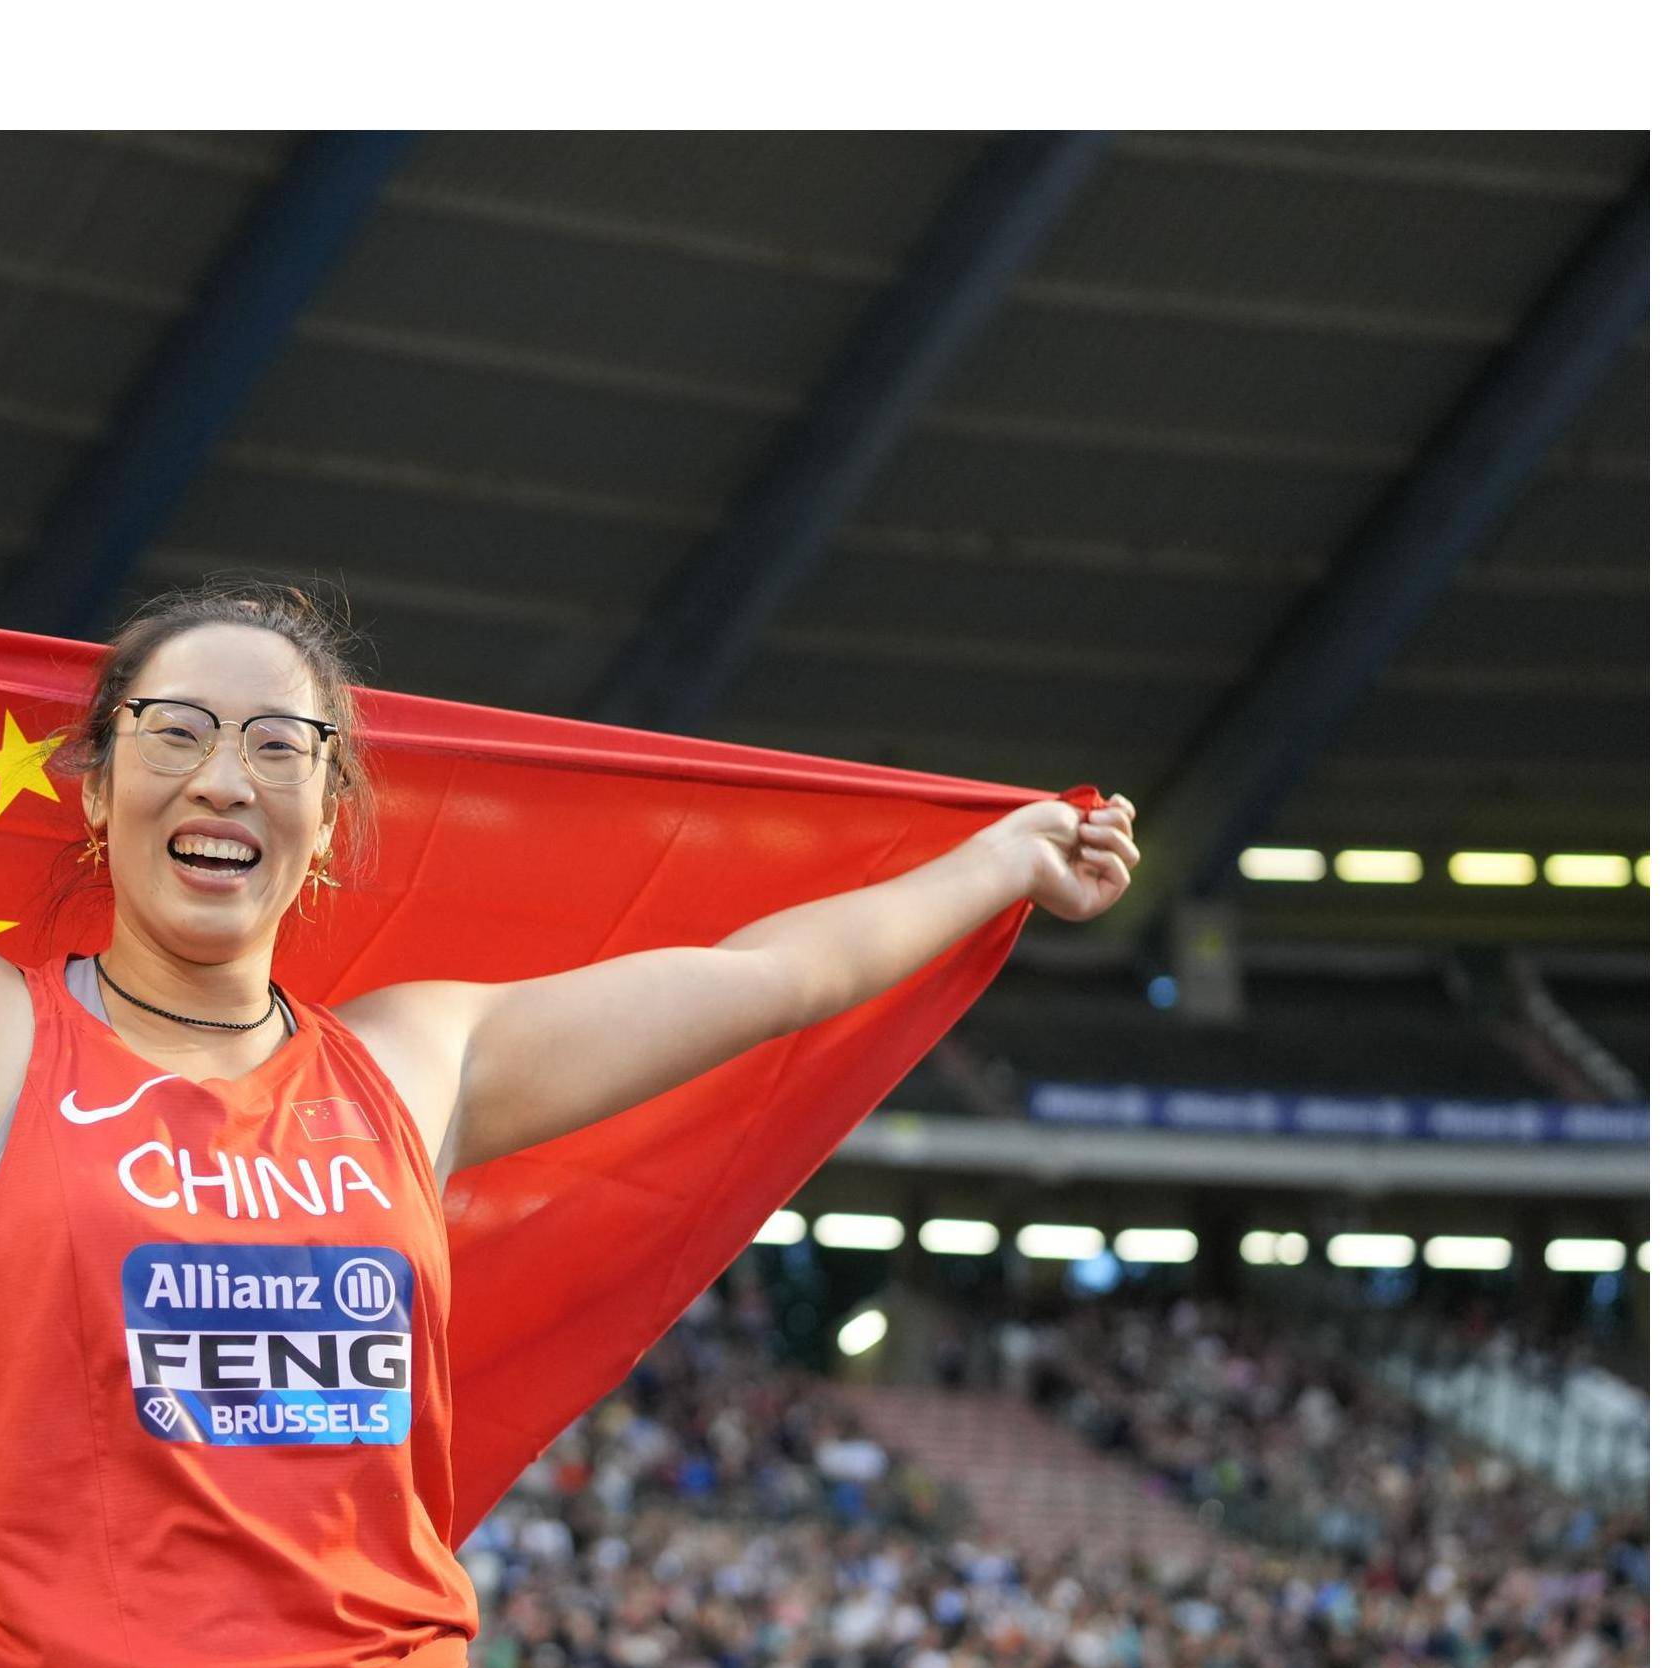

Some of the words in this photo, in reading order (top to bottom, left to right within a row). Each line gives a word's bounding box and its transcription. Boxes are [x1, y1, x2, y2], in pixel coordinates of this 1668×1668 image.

[117, 1140, 393, 1220] CHINA
[143, 1262, 322, 1311] Allianz
[137, 1333, 407, 1390] FENG
[210, 1403, 391, 1435] BRUSSELS
